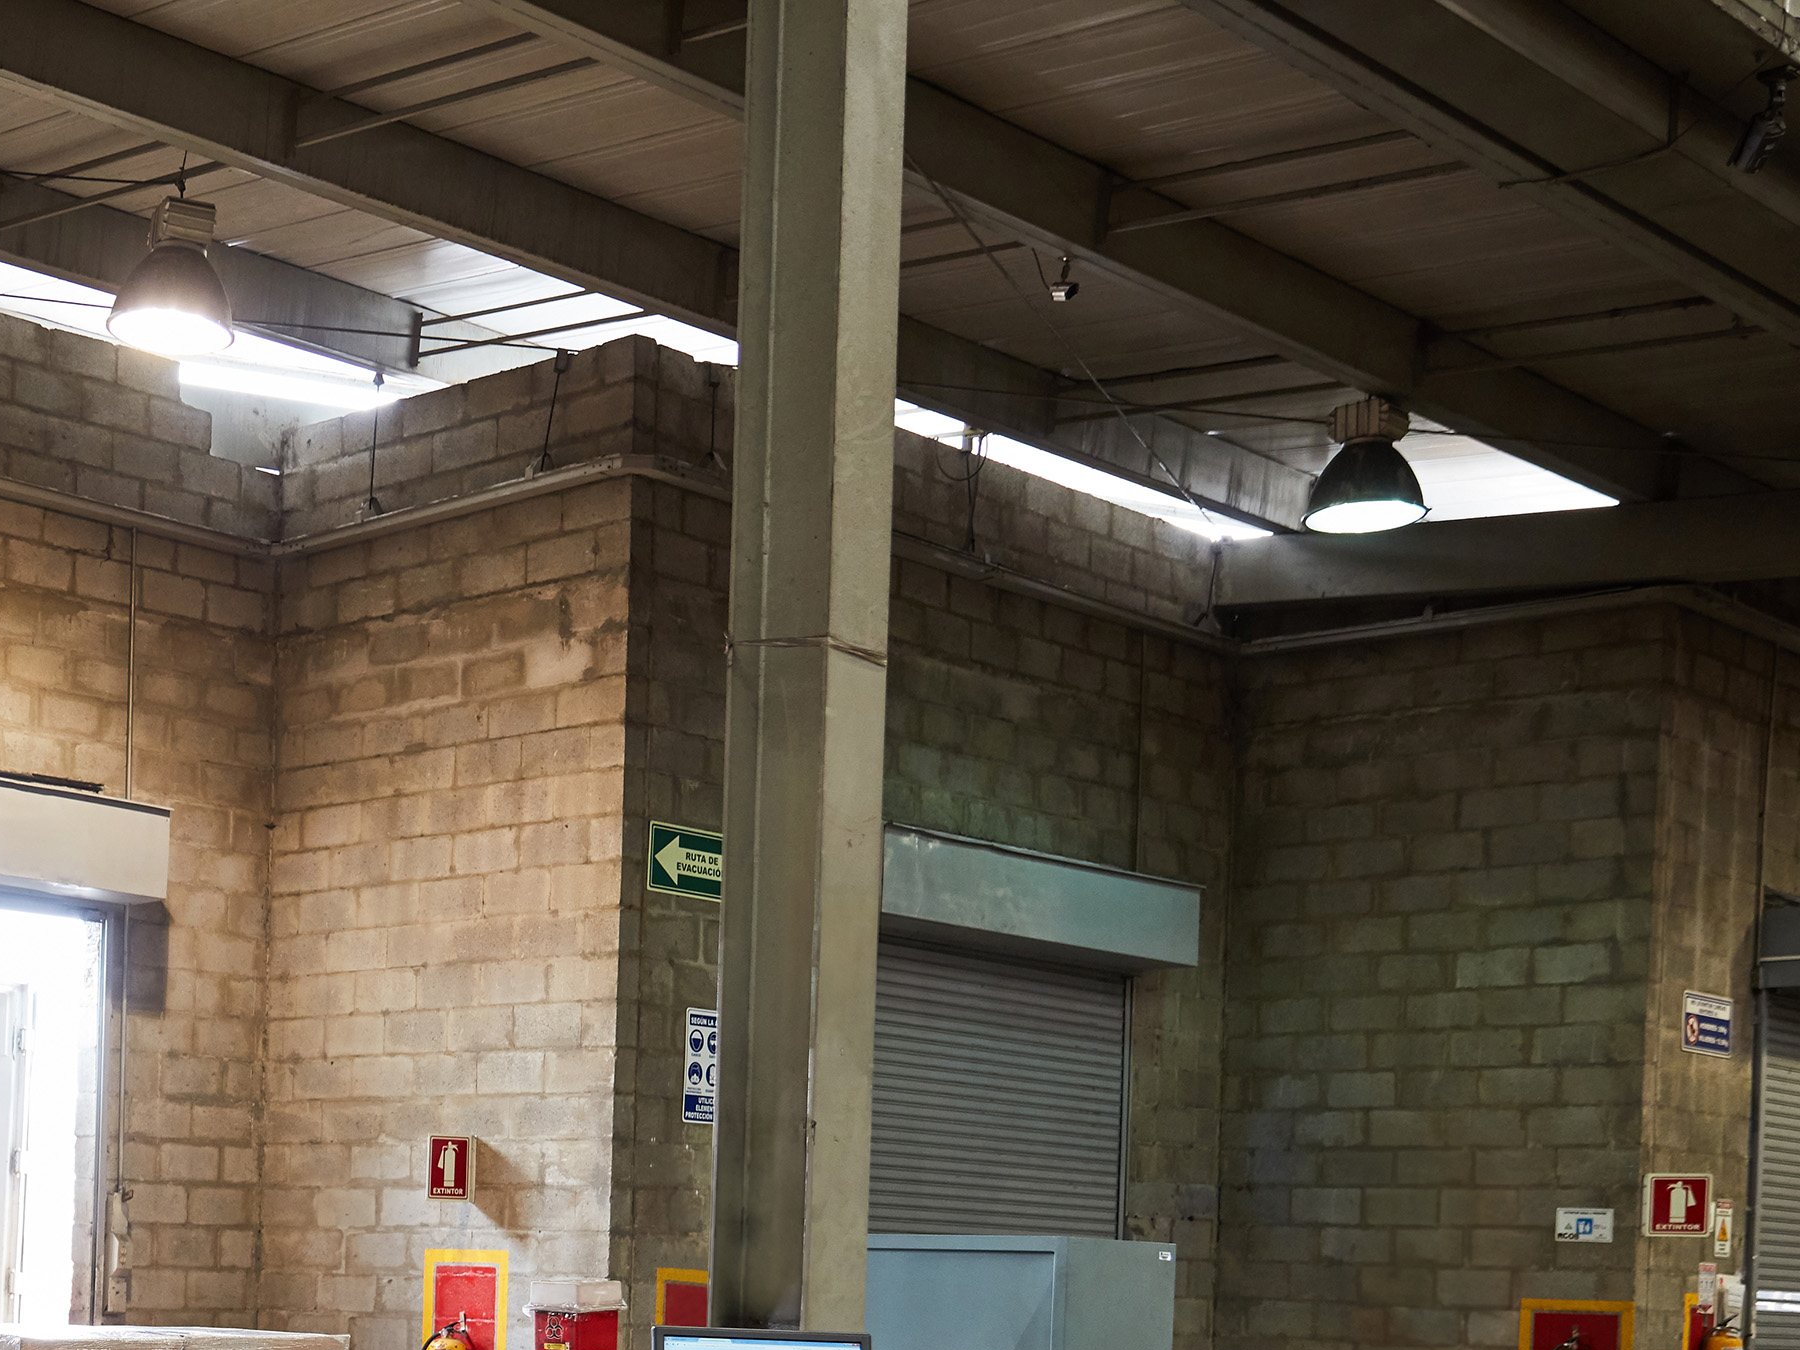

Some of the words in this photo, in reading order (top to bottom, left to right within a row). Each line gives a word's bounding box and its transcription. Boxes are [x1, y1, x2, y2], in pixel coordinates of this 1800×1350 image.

[686, 852, 706, 863] RUTA
[708, 856, 719, 866] DE
[676, 862, 721, 878] EVACUACIÓ
[432, 1187, 464, 1195] EXTINTOR
[1655, 1222, 1701, 1231] EXTINTOR
